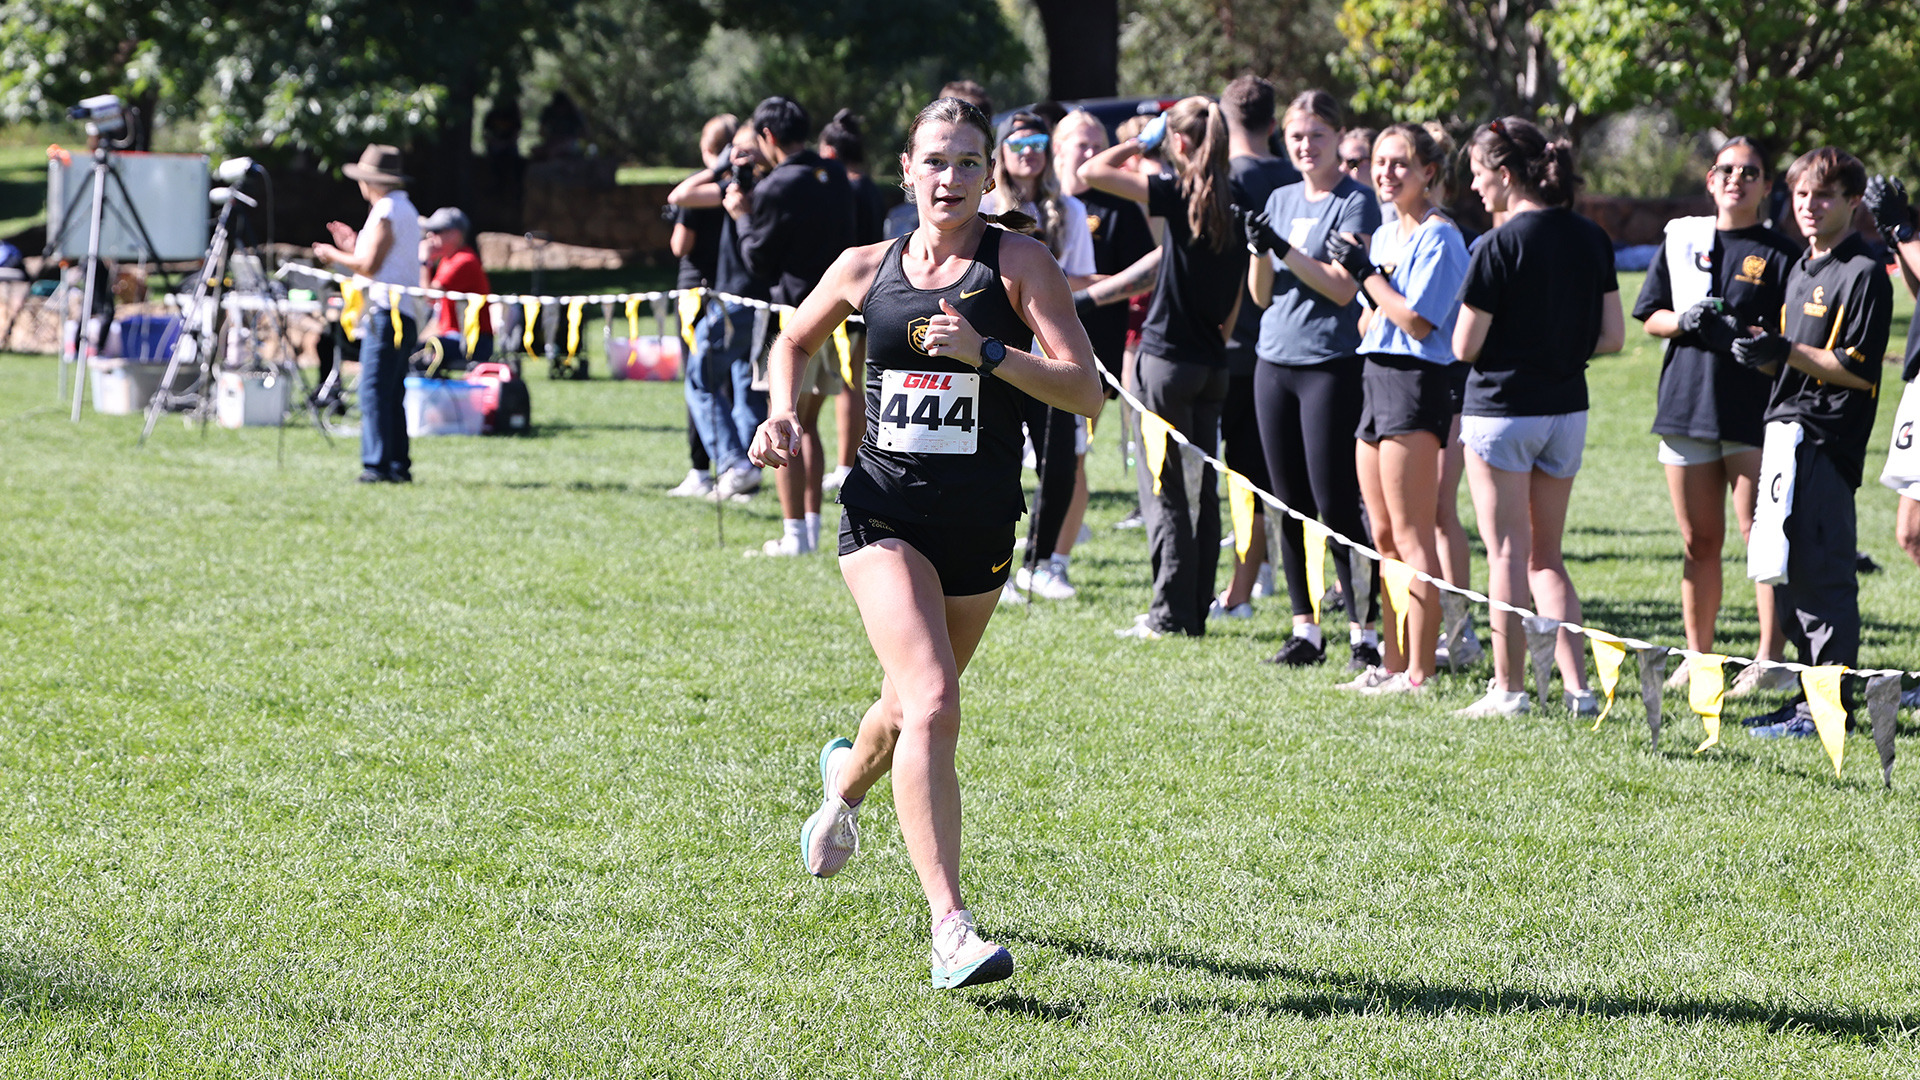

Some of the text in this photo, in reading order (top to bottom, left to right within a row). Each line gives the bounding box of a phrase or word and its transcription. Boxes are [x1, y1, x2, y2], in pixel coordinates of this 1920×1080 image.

[903, 373, 953, 390] GILL
[881, 393, 976, 433] 444
[1895, 420, 1914, 450] G
